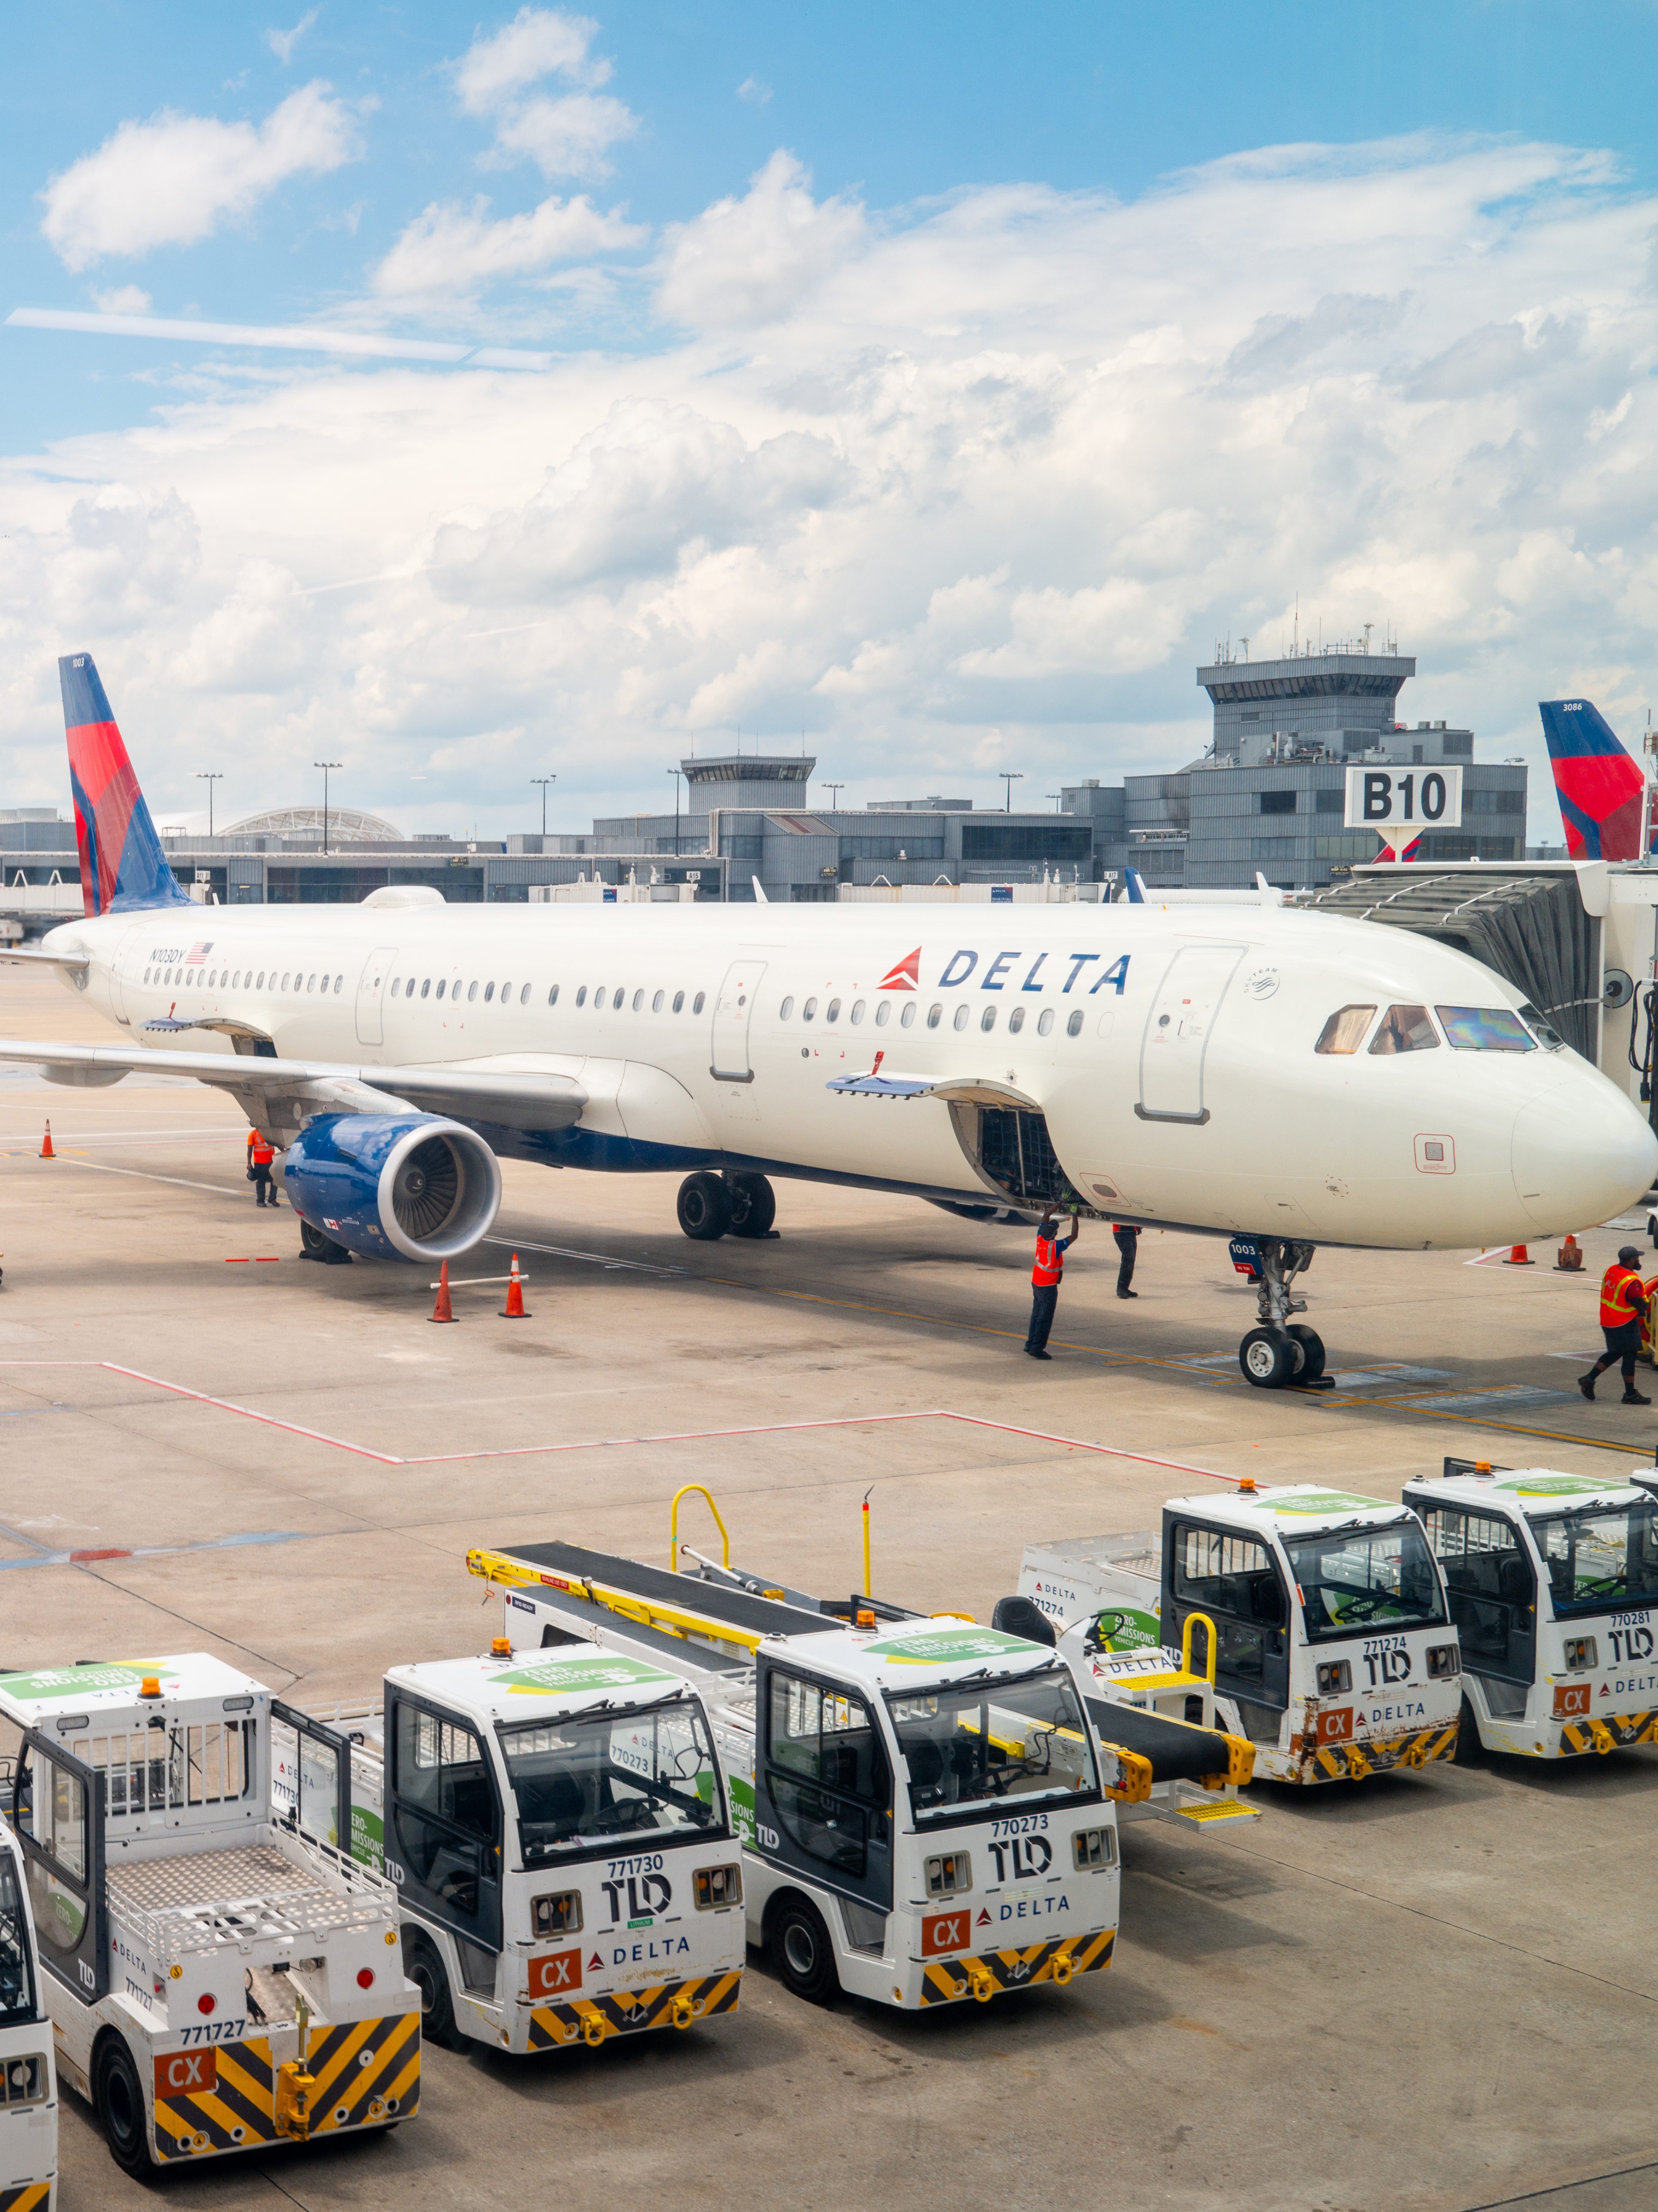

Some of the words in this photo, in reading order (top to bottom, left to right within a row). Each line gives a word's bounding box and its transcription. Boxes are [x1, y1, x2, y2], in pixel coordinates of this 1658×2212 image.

[73, 657, 84, 668] 1003
[1563, 703, 1582, 711] 3086
[1363, 772, 1446, 820] B10
[149, 948, 187, 964] N103DY
[938, 950, 1131, 995] DELTA
[1244, 967, 1278, 993] SKYTEAM
[1231, 1244, 1256, 1255] 1003
[1285, 1498, 1357, 1508] EMISSIONS
[1045, 1584, 1076, 1601] DELTA
[1611, 1611, 1650, 1627] 770281
[865, 1630, 927, 1640] DELTA
[888, 1638, 940, 1648] ZERO-
[1114, 1636, 1134, 1648] VEHICLE
[1364, 1636, 1407, 1654] 771274
[1608, 1627, 1654, 1663] TLD
[903, 1637, 996, 1655] EMISSIONS
[918, 1648, 963, 1658] VEHICLE
[1162, 1645, 1183, 1665] TLD
[497, 1657, 562, 1668] DELTA
[518, 1666, 573, 1678] ZERO-
[1109, 1656, 1173, 1674] DELTA
[1363, 1650, 1412, 1686] TLD
[530, 1667, 630, 1683] EMISSIONS
[544, 1677, 592, 1687] VEHICLE
[1616, 1676, 1658, 1693] DELT
[1564, 1690, 1584, 1711] CX
[1373, 1702, 1425, 1722] DELTA
[1325, 1713, 1346, 1736] CX
[611, 1745, 648, 1772] 770273
[352, 1812, 368, 1831] ERO-
[730, 1800, 755, 1823] SIONS
[755, 1822, 780, 1850] TLD
[991, 1814, 1049, 1837] 770273
[351, 1829, 384, 1856] MISSIONS
[351, 1845, 365, 1857] EHICLE
[608, 1854, 663, 1878] 771730
[987, 1835, 1053, 1882] TLD
[384, 1856, 405, 1886] TLD
[601, 1874, 672, 1923] TLD
[1000, 1895, 1070, 1921] DELTA
[630, 1919, 650, 1928] LITHIUM
[933, 1918, 960, 1947] CX
[120, 1943, 146, 1975] DELTA
[613, 1937, 690, 1965] DELTA
[78, 1957, 96, 1991] TLD
[541, 1958, 571, 1989] CX
[126, 1976, 153, 2012] 771727
[180, 2018, 246, 2045] 771727
[168, 2055, 203, 2088] CX
